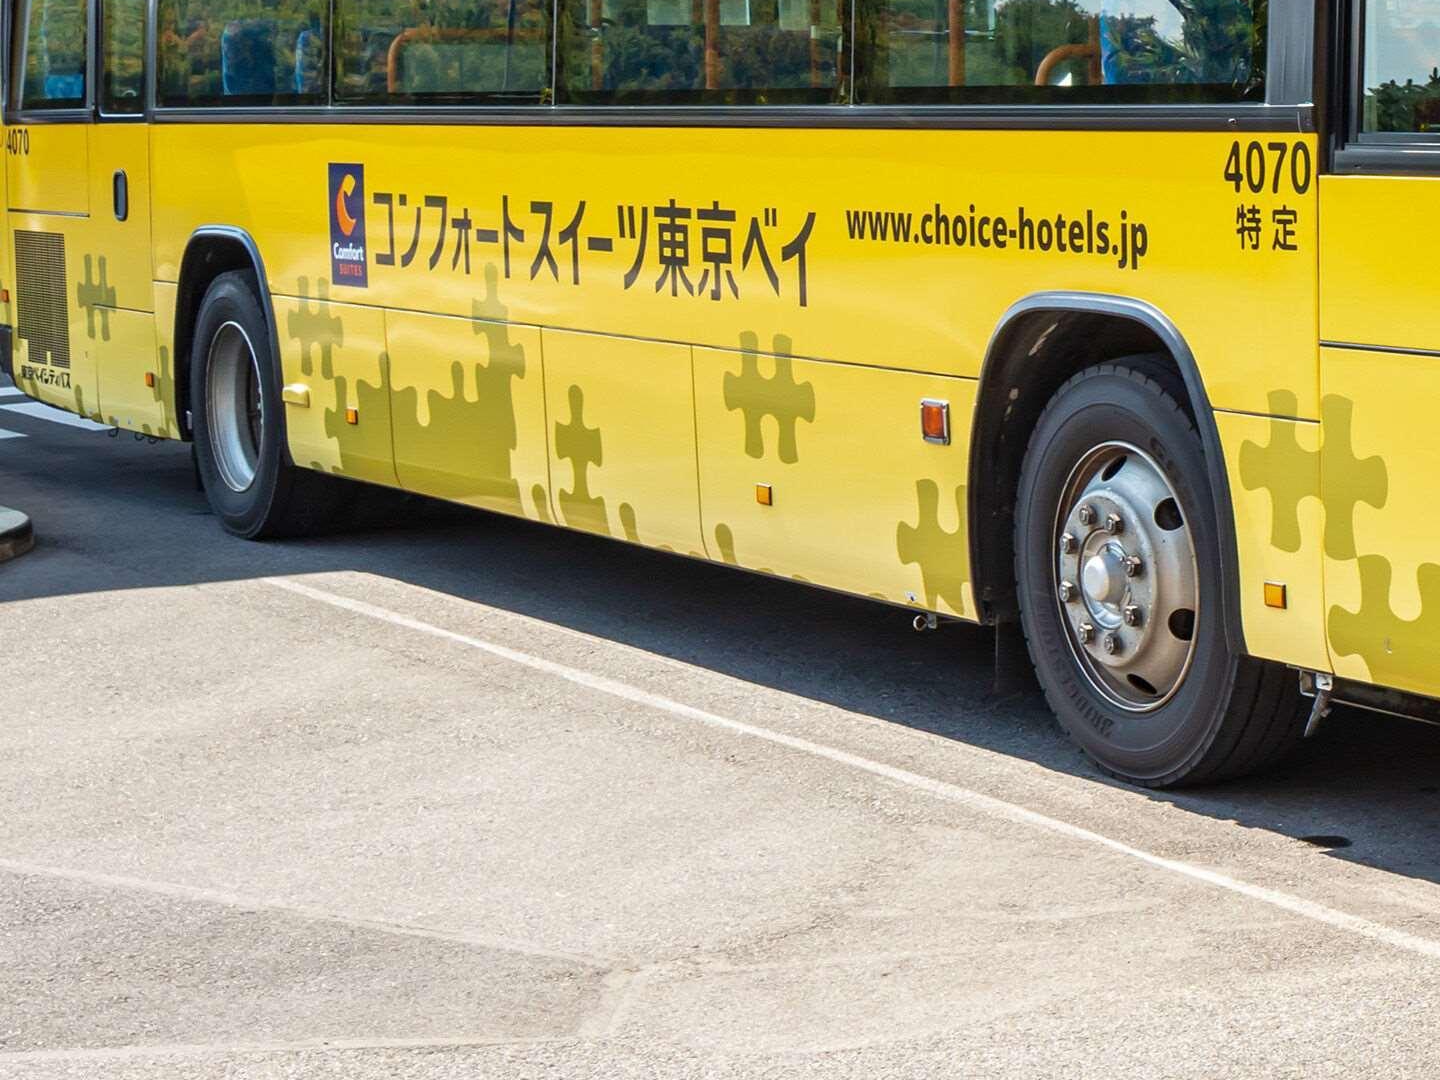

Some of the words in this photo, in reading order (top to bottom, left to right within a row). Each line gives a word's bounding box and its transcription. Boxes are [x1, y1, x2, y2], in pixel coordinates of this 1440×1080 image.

[6, 128, 30, 156] 4070
[1224, 141, 1311, 195] 4070
[333, 241, 364, 261] Comfort
[373, 192, 817, 307] コンフォートスイーツ東京ベイ
[847, 203, 1148, 270] www.choice-hotels.jp
[1236, 204, 1299, 251] 特定
